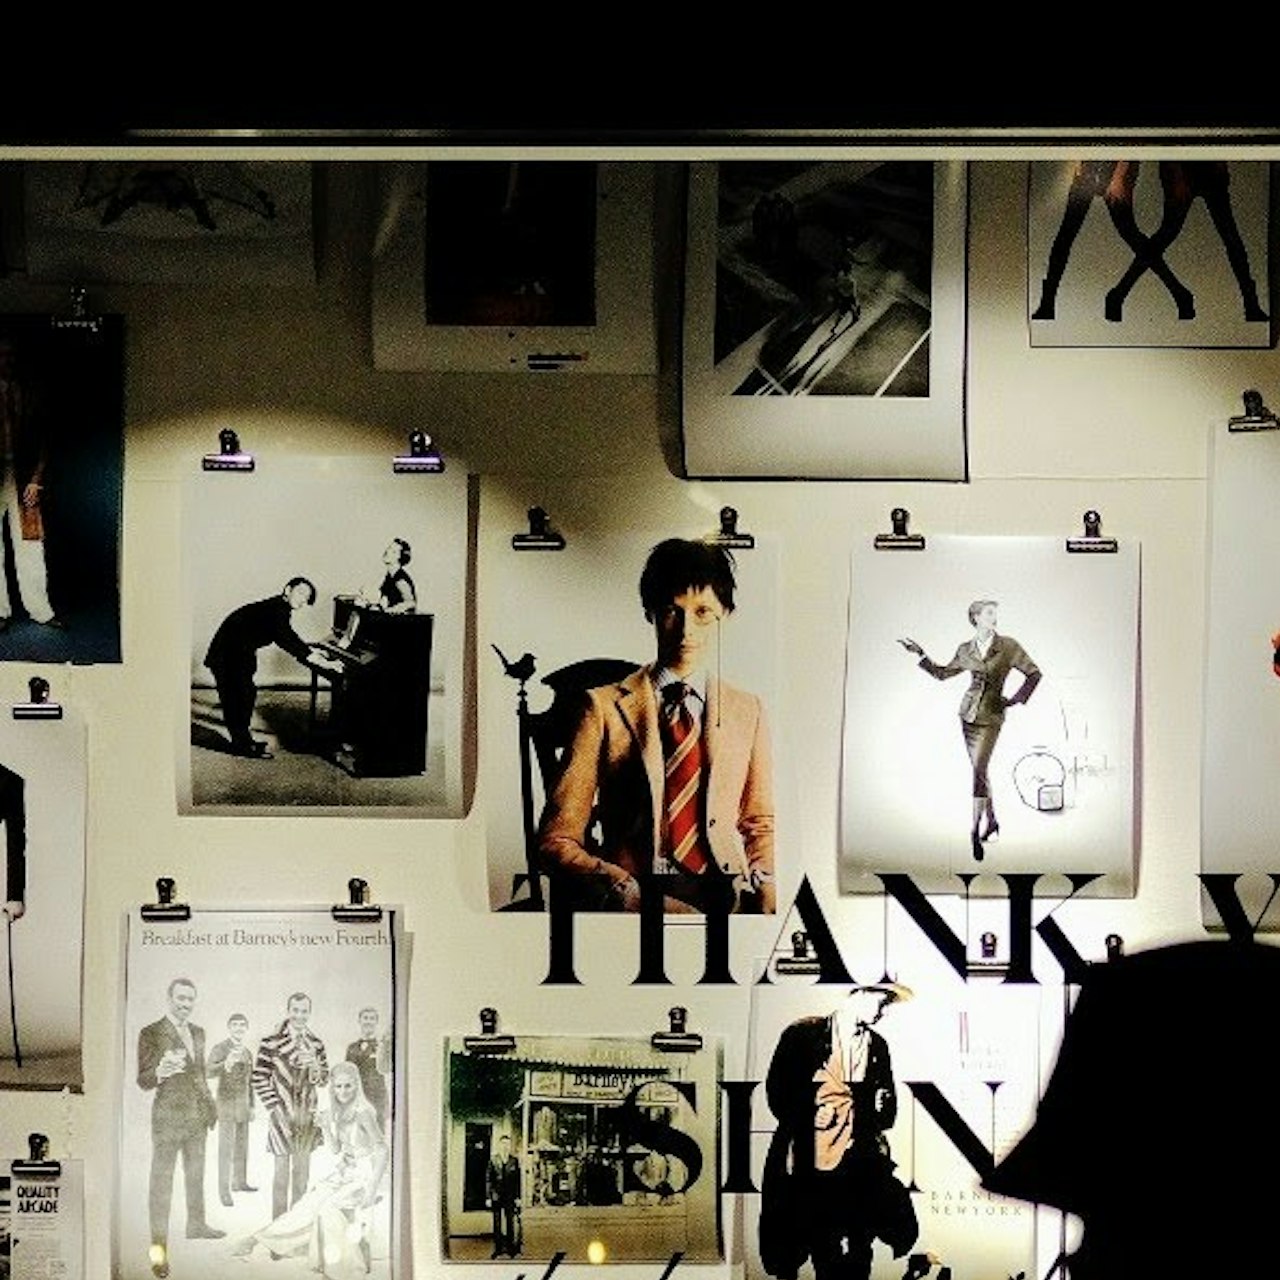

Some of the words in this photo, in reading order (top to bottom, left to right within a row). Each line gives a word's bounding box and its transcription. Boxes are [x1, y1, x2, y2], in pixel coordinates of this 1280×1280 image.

[142, 930, 212, 946] Breakfast
[216, 931, 230, 946] at
[233, 930, 297, 950] Barney's
[300, 935, 333, 946] new
[510, 872, 1108, 986] THANK
